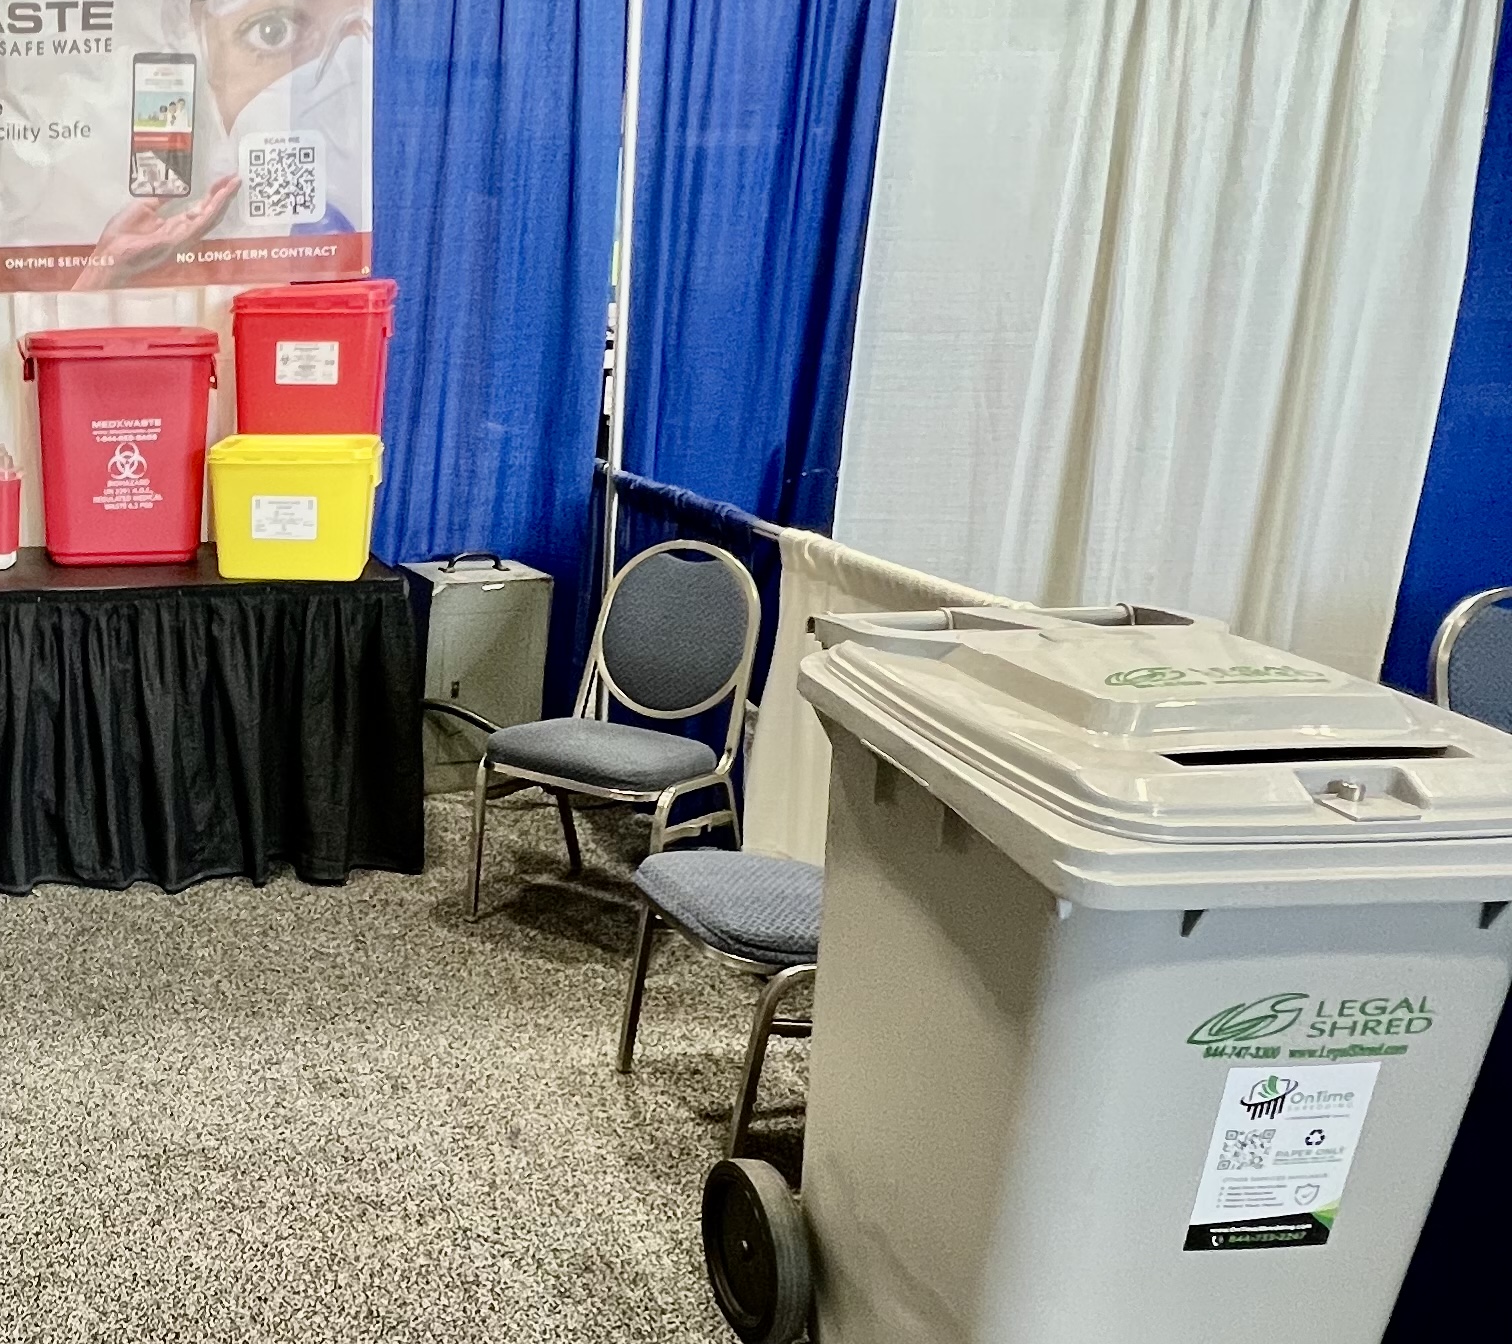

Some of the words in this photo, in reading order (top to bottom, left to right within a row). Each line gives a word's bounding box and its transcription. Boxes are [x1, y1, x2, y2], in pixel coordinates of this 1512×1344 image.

[0, 40, 45, 56] SAFE
[53, 38, 112, 54] WASTE
[48, 121, 91, 139] Safe
[5, 258, 54, 270] ON-TIME
[57, 255, 115, 269] SERVICES
[176, 252, 195, 263] NO
[197, 249, 268, 262] LONG-TERM
[270, 245, 337, 259] CONTRACT
[1316, 996, 1435, 1018] LEGAL
[1306, 1016, 1434, 1038] SHRED
[1290, 1090, 1355, 1105] OnTime
